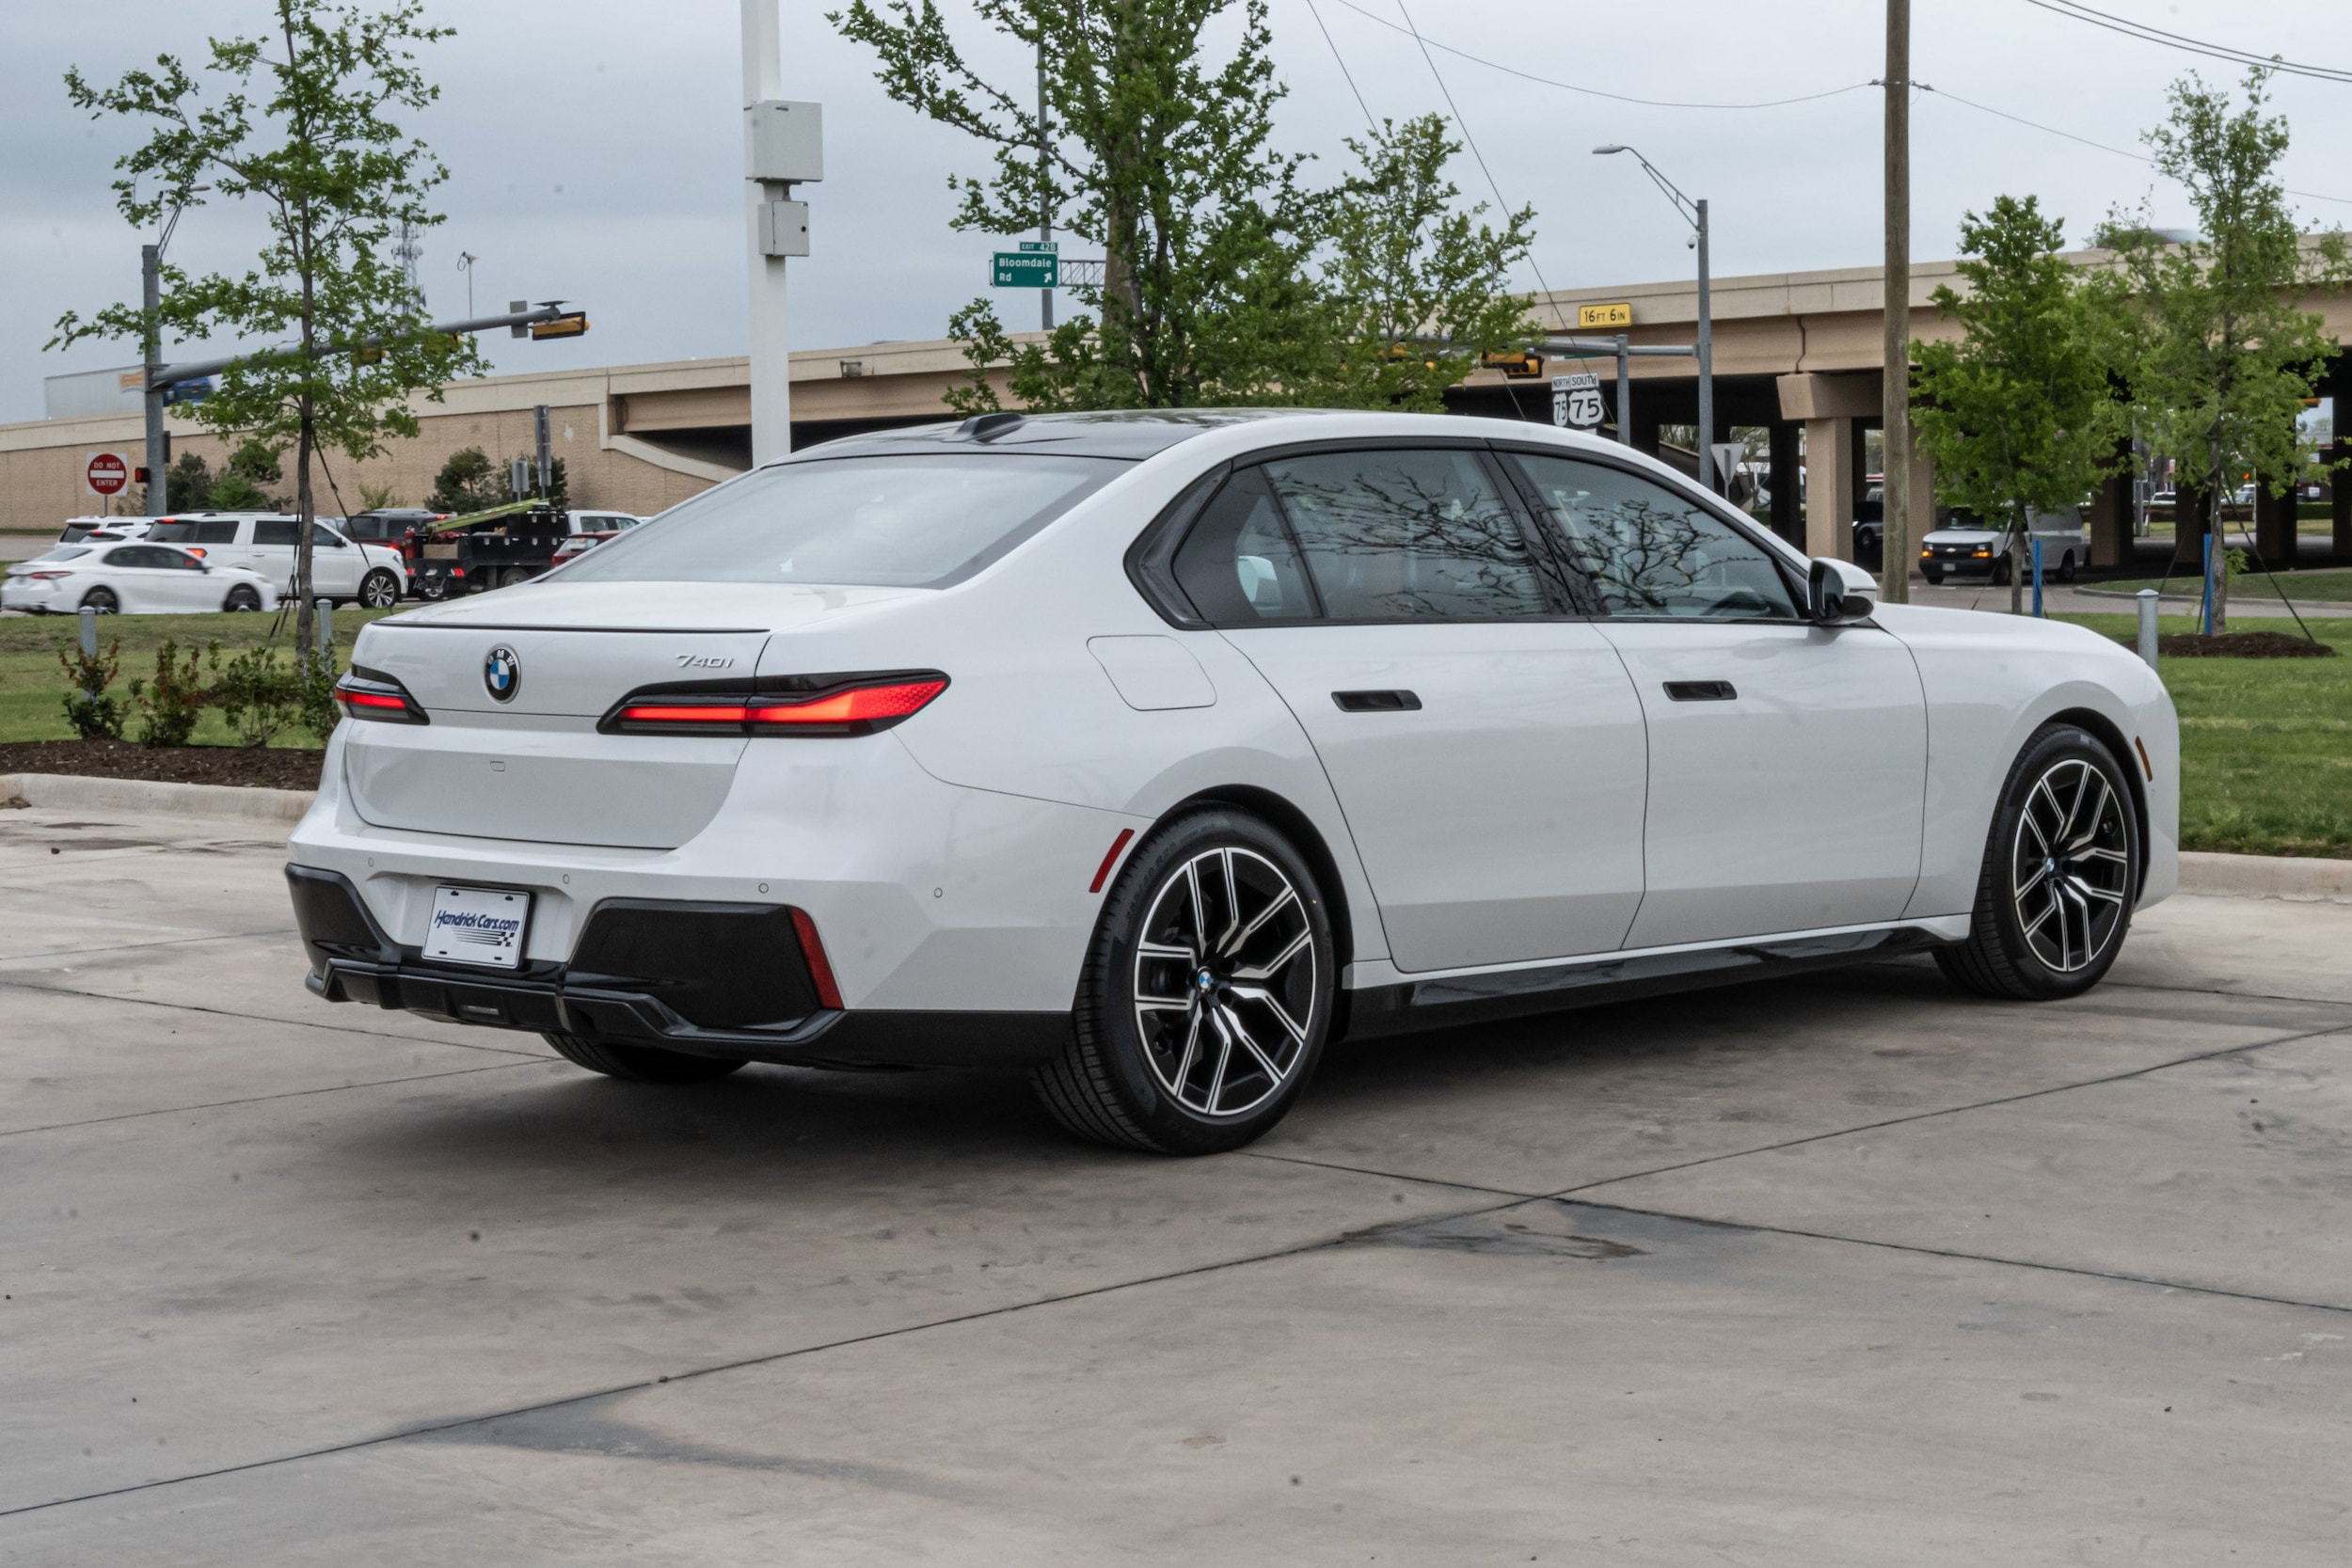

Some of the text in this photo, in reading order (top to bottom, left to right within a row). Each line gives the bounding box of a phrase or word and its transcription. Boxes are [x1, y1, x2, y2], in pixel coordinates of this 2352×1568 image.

[998, 257, 1052, 268] Bloomdale
[998, 272, 1012, 282] Rd
[1552, 377, 1570, 388] NORTH
[1571, 374, 1597, 387] SOUTH
[1554, 400, 1566, 421] 75
[1571, 398, 1600, 420] 75
[487, 649, 516, 667] BMW
[675, 654, 735, 669] 740i
